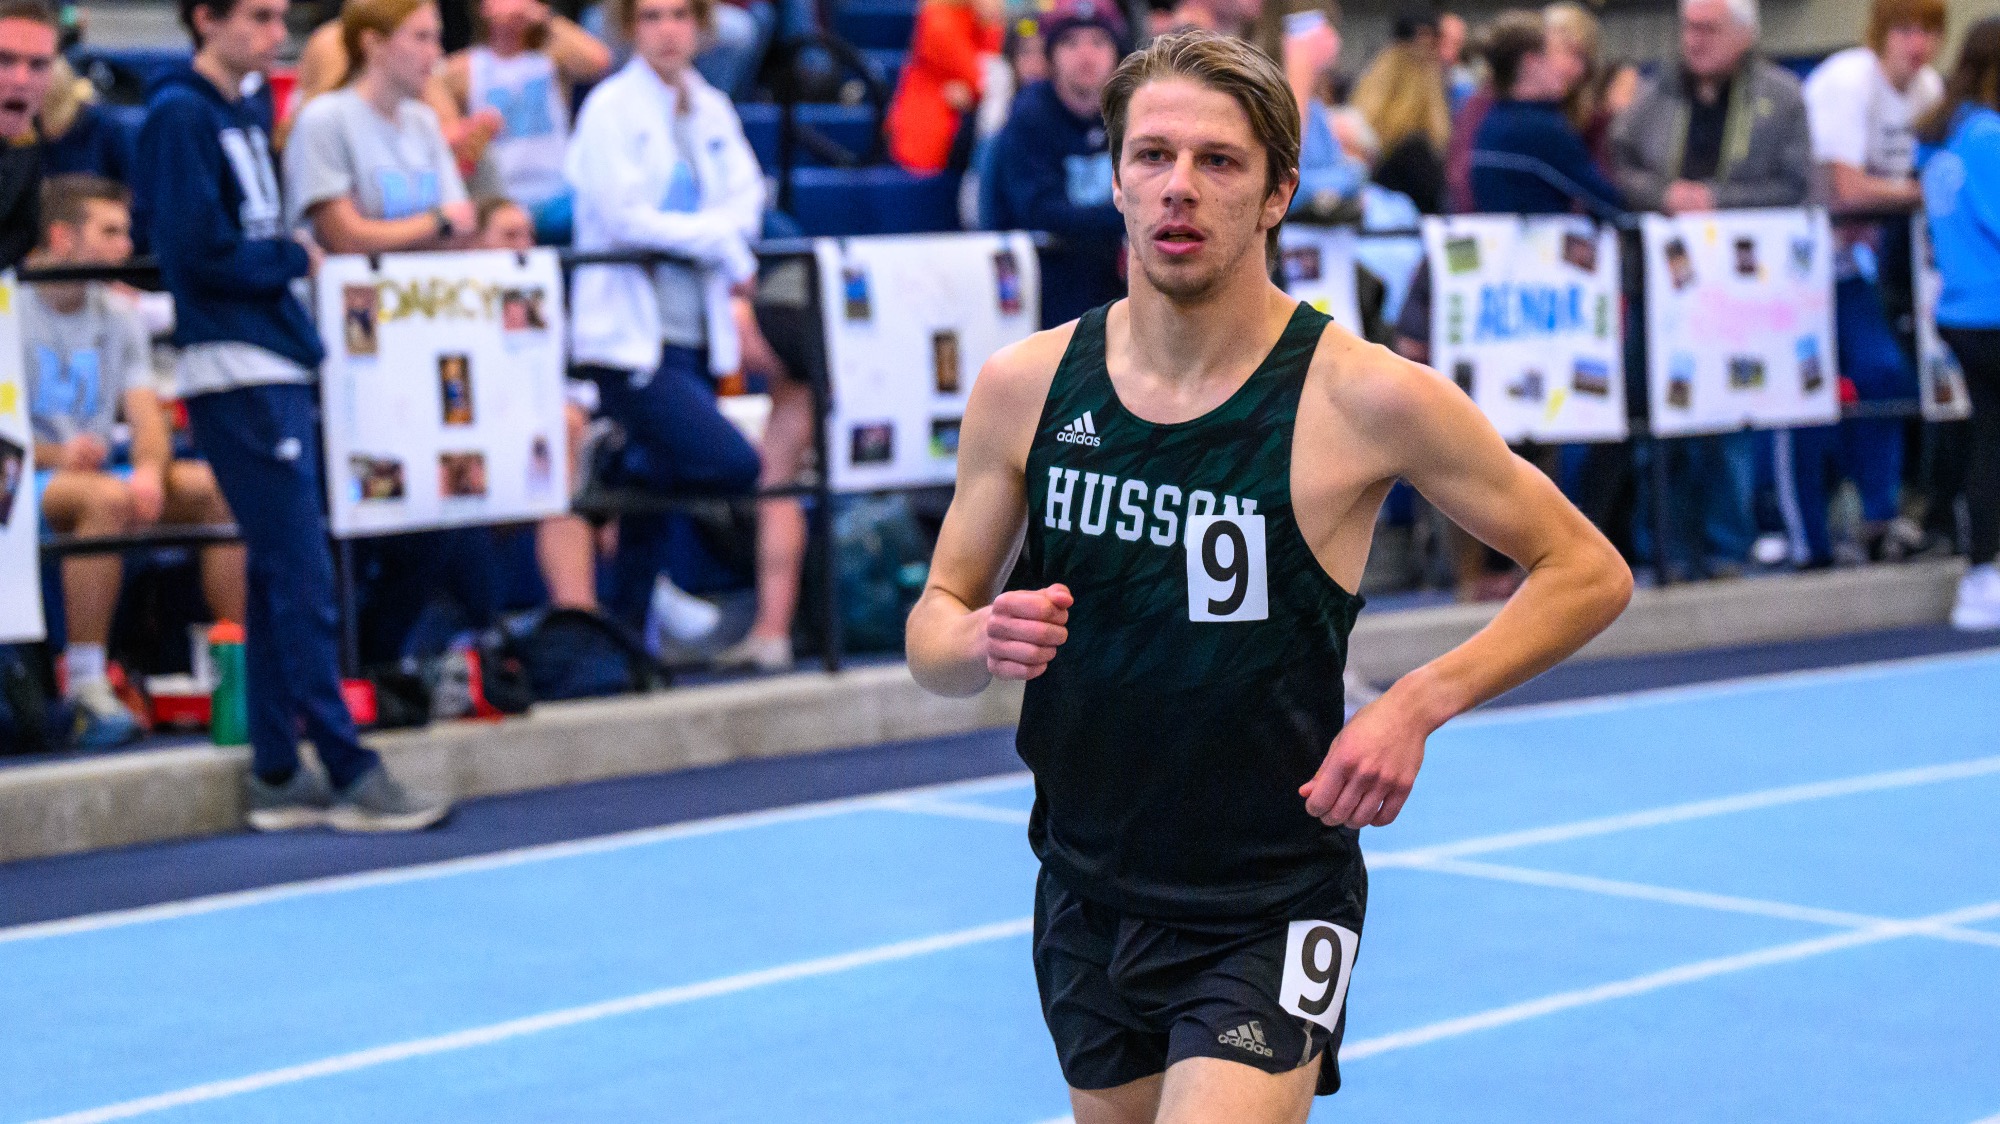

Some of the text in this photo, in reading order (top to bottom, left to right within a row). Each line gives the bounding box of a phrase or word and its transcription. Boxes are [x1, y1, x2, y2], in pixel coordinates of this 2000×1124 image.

[1056, 431, 1101, 447] adidas
[1044, 465, 1258, 551] HUSS
[1201, 519, 1249, 616] 9
[1297, 925, 1343, 1016] 9
[1217, 1033, 1274, 1059] adidas
